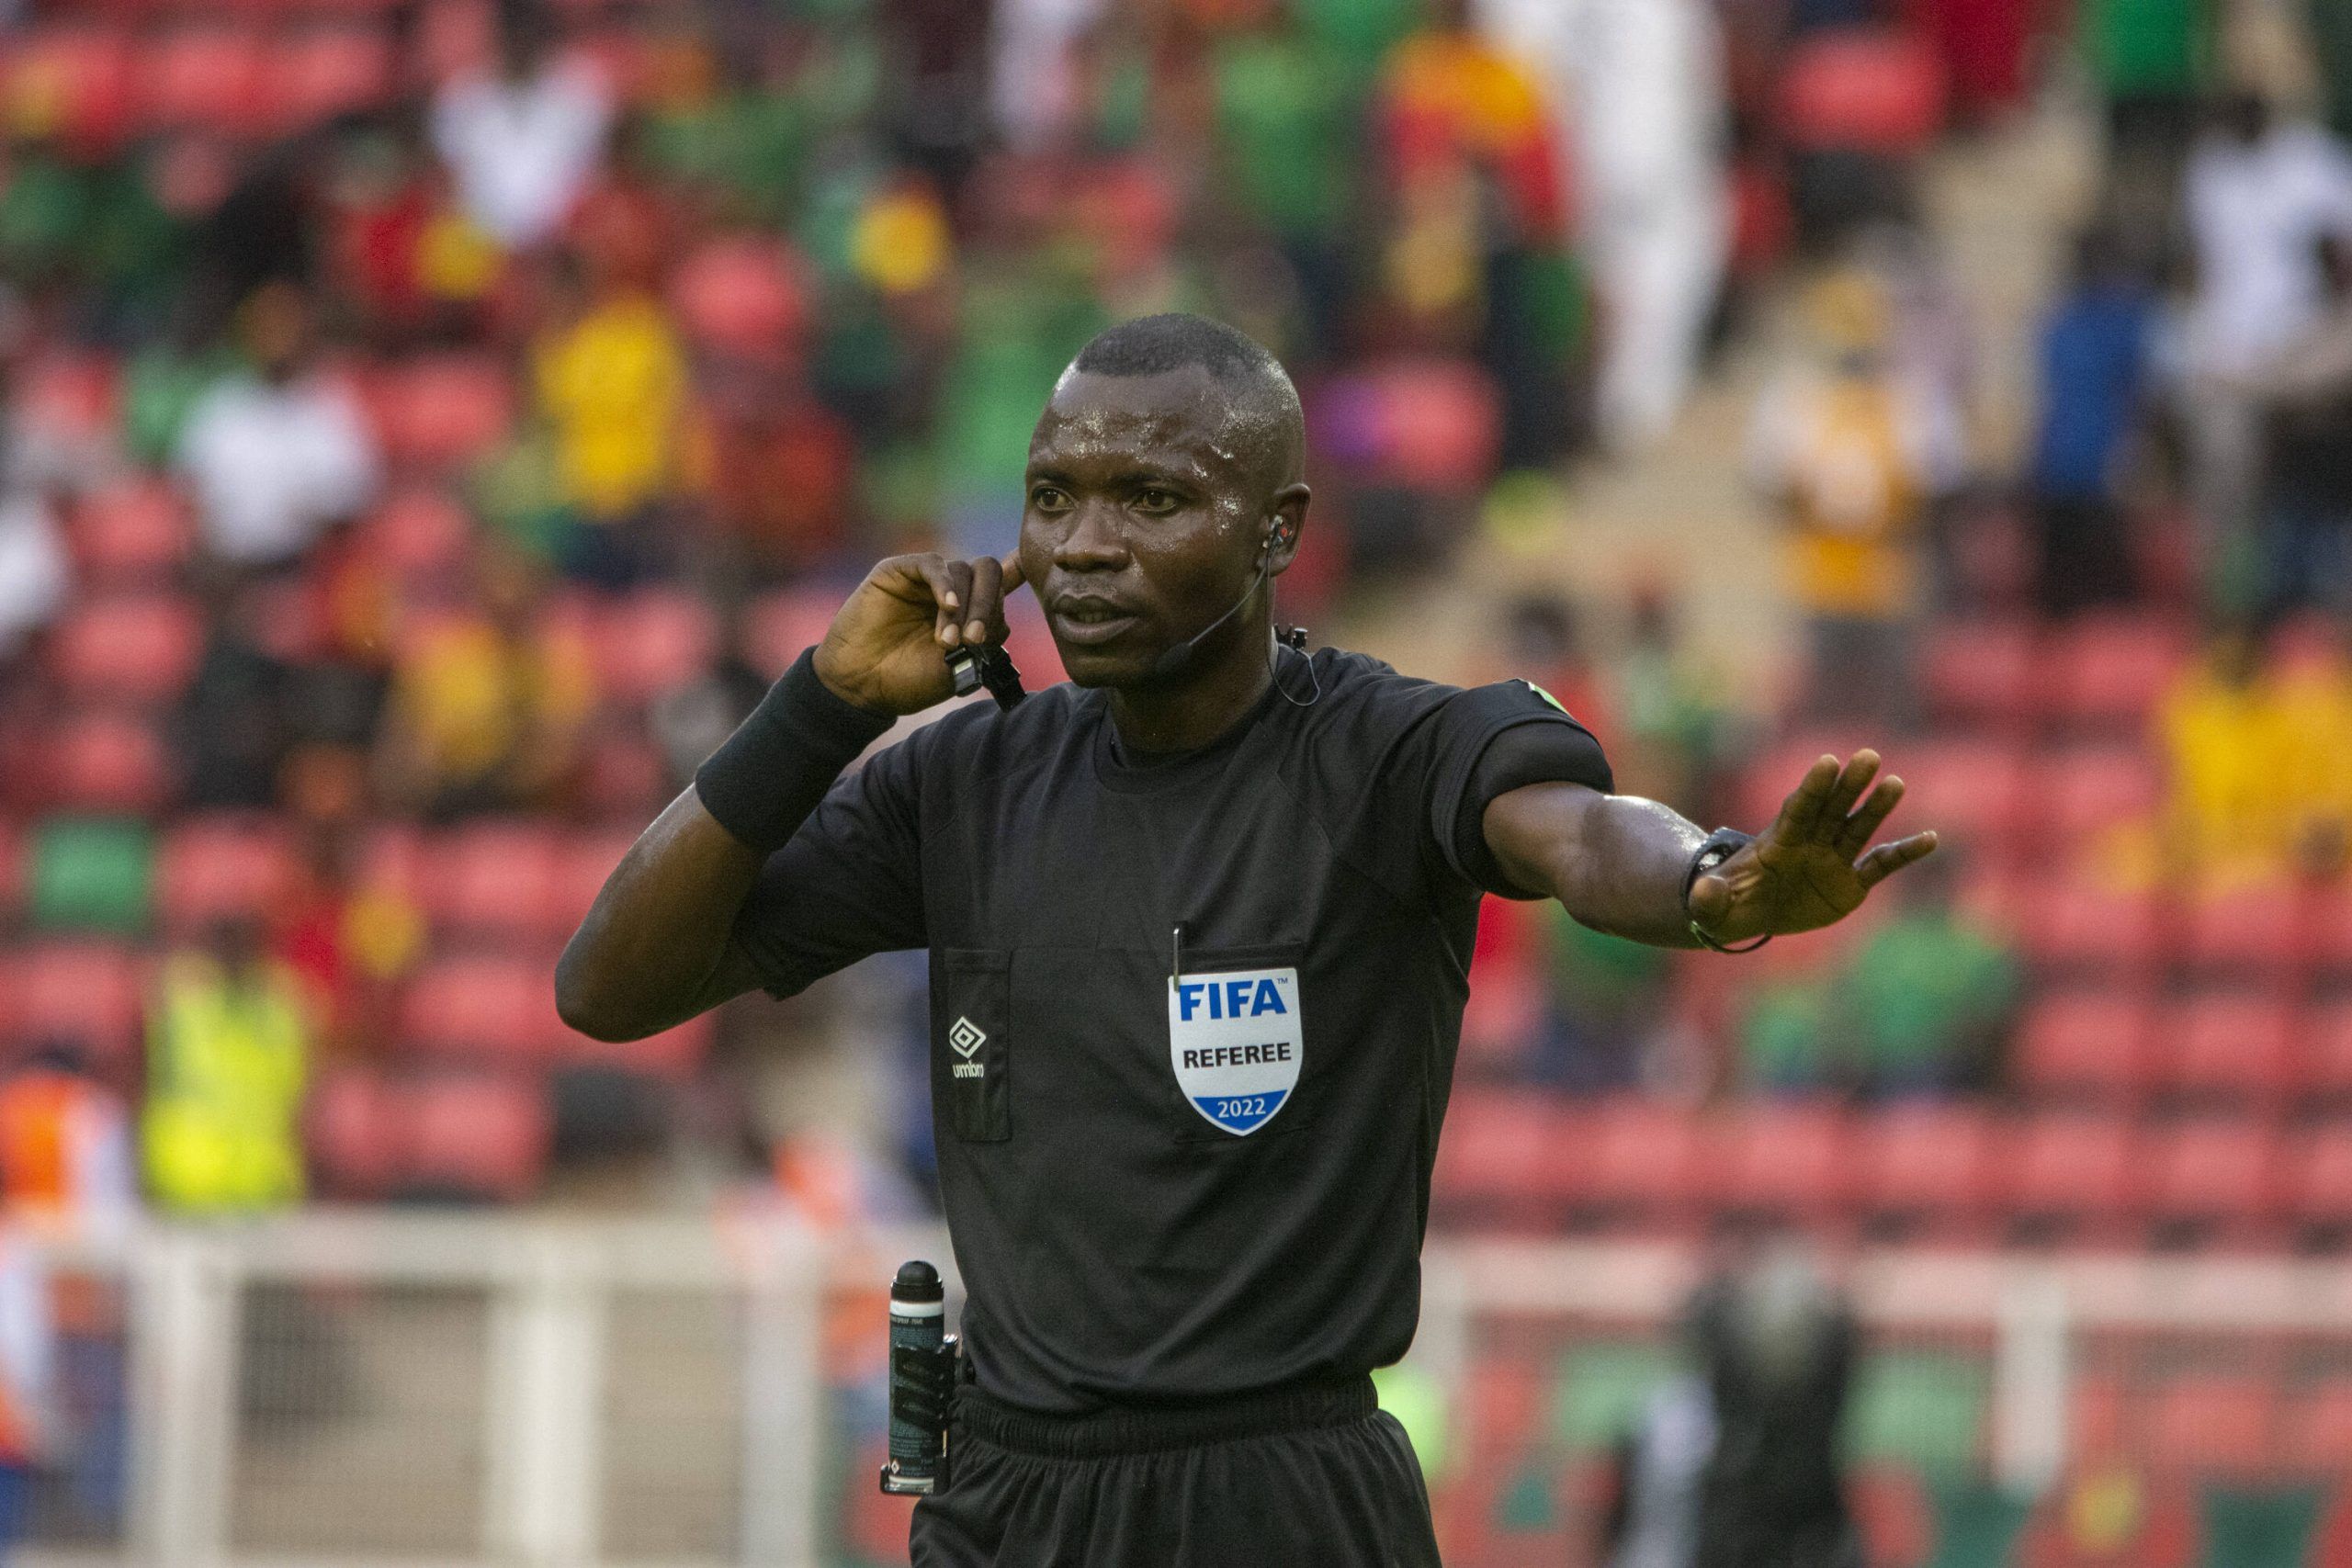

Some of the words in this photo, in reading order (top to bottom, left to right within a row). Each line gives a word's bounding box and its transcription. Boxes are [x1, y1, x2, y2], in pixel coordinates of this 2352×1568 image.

[1179, 978, 1288, 1022] FIFA
[1182, 1042, 1292, 1070] REFEREE
[952, 1059, 985, 1079] umbro
[1217, 1097, 1267, 1119] 2022
